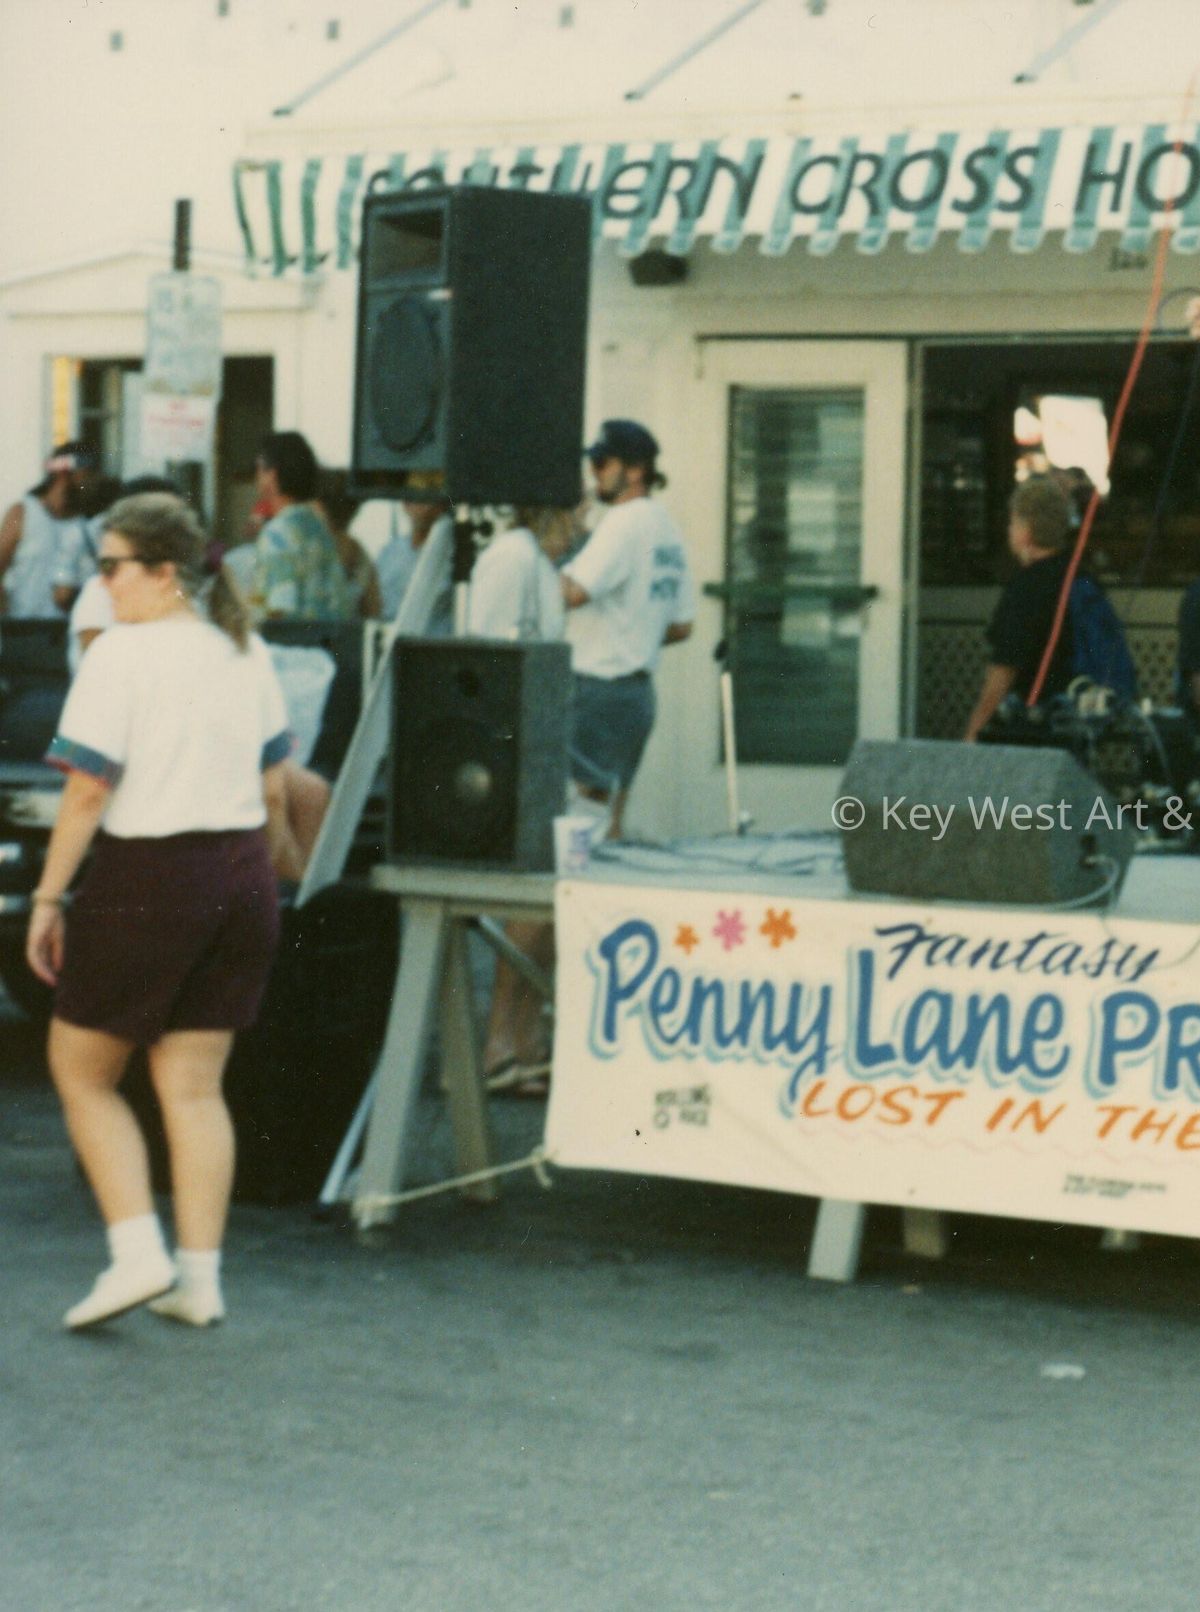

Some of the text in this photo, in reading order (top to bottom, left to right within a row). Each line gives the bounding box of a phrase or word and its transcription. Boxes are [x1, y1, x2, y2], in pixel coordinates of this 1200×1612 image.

[788, 145, 1041, 215] CROSS
[873, 921, 1160, 982] Fantasy
[593, 918, 835, 1112] Penny
[850, 947, 1071, 1090] Lane
[802, 1080, 968, 1128] LOST
[985, 1096, 1066, 1134] IN
